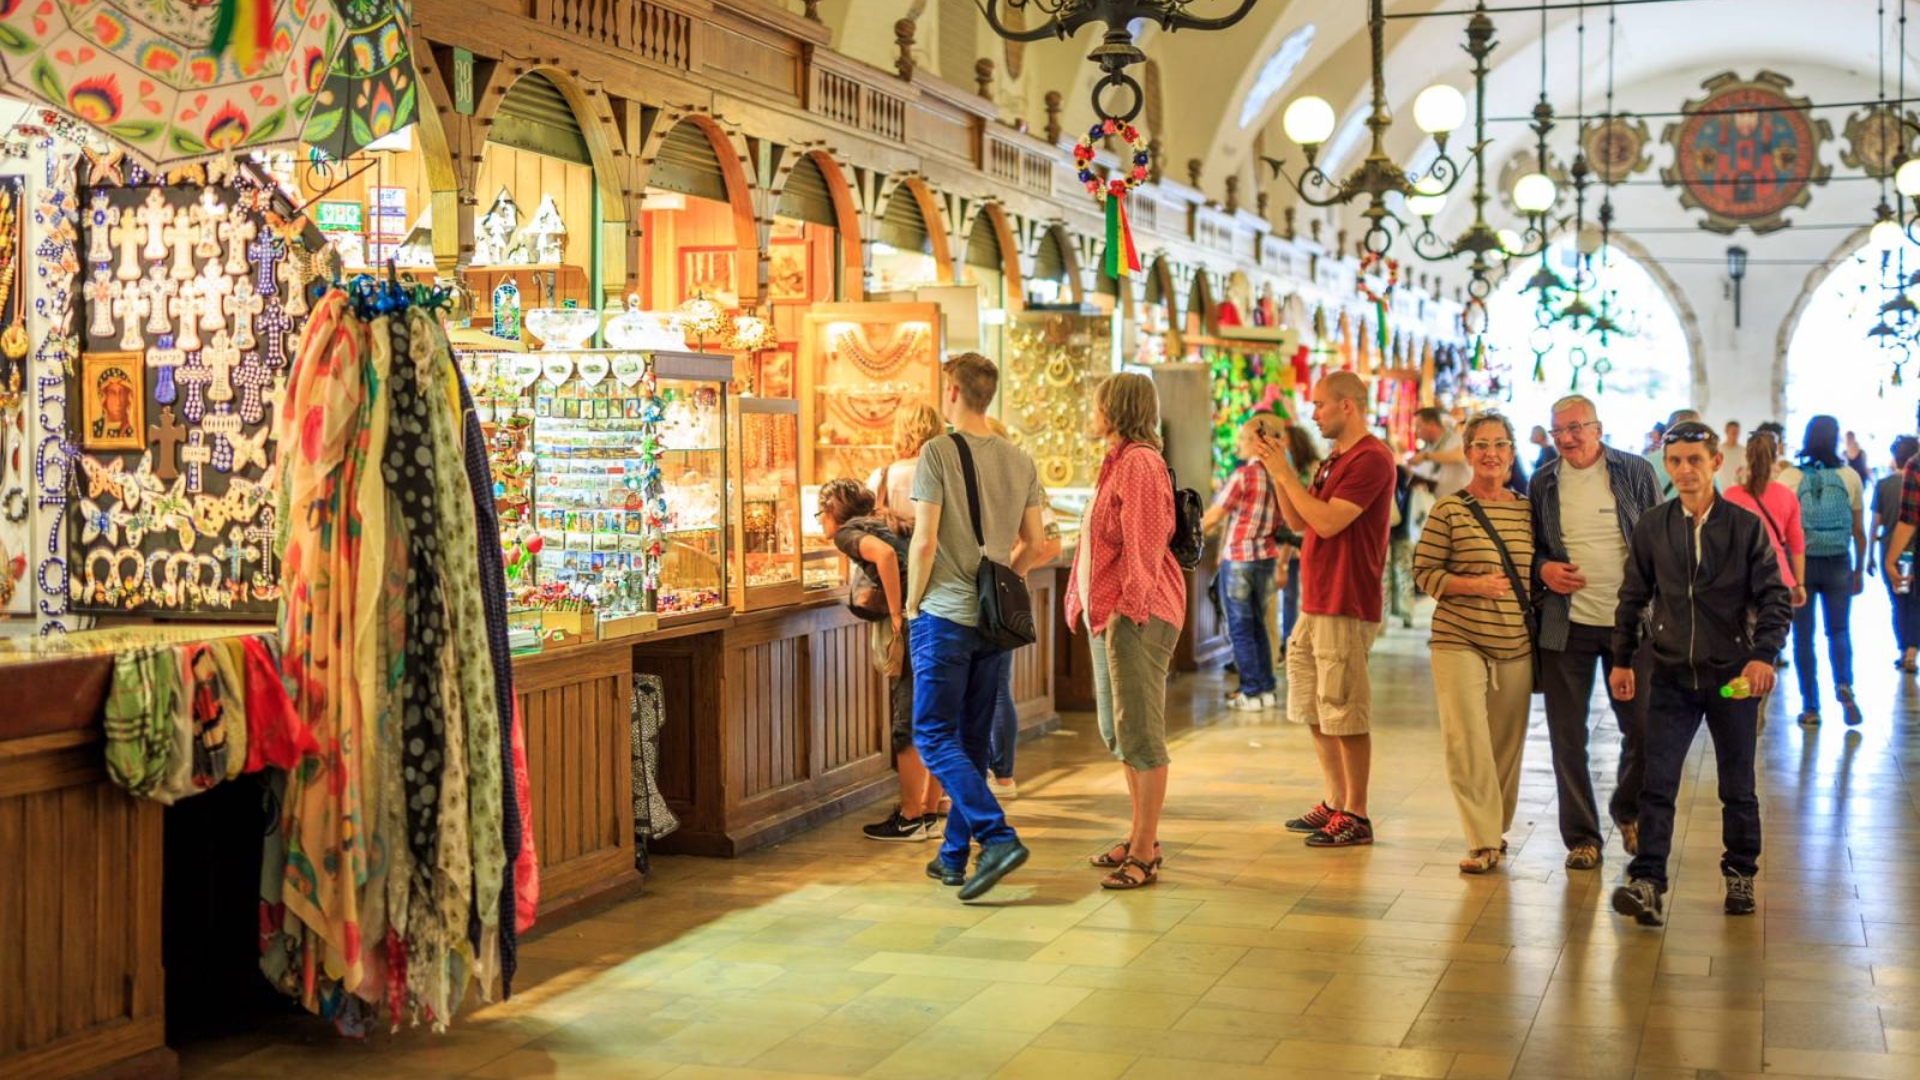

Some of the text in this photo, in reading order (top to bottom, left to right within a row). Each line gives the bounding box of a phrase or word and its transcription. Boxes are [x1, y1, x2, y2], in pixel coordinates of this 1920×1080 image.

[454, 60, 472, 103] 38
[38, 376, 67, 433] 5
[35, 434, 68, 494] 6
[38, 496, 67, 553] 7
[37, 557, 68, 617] 9
